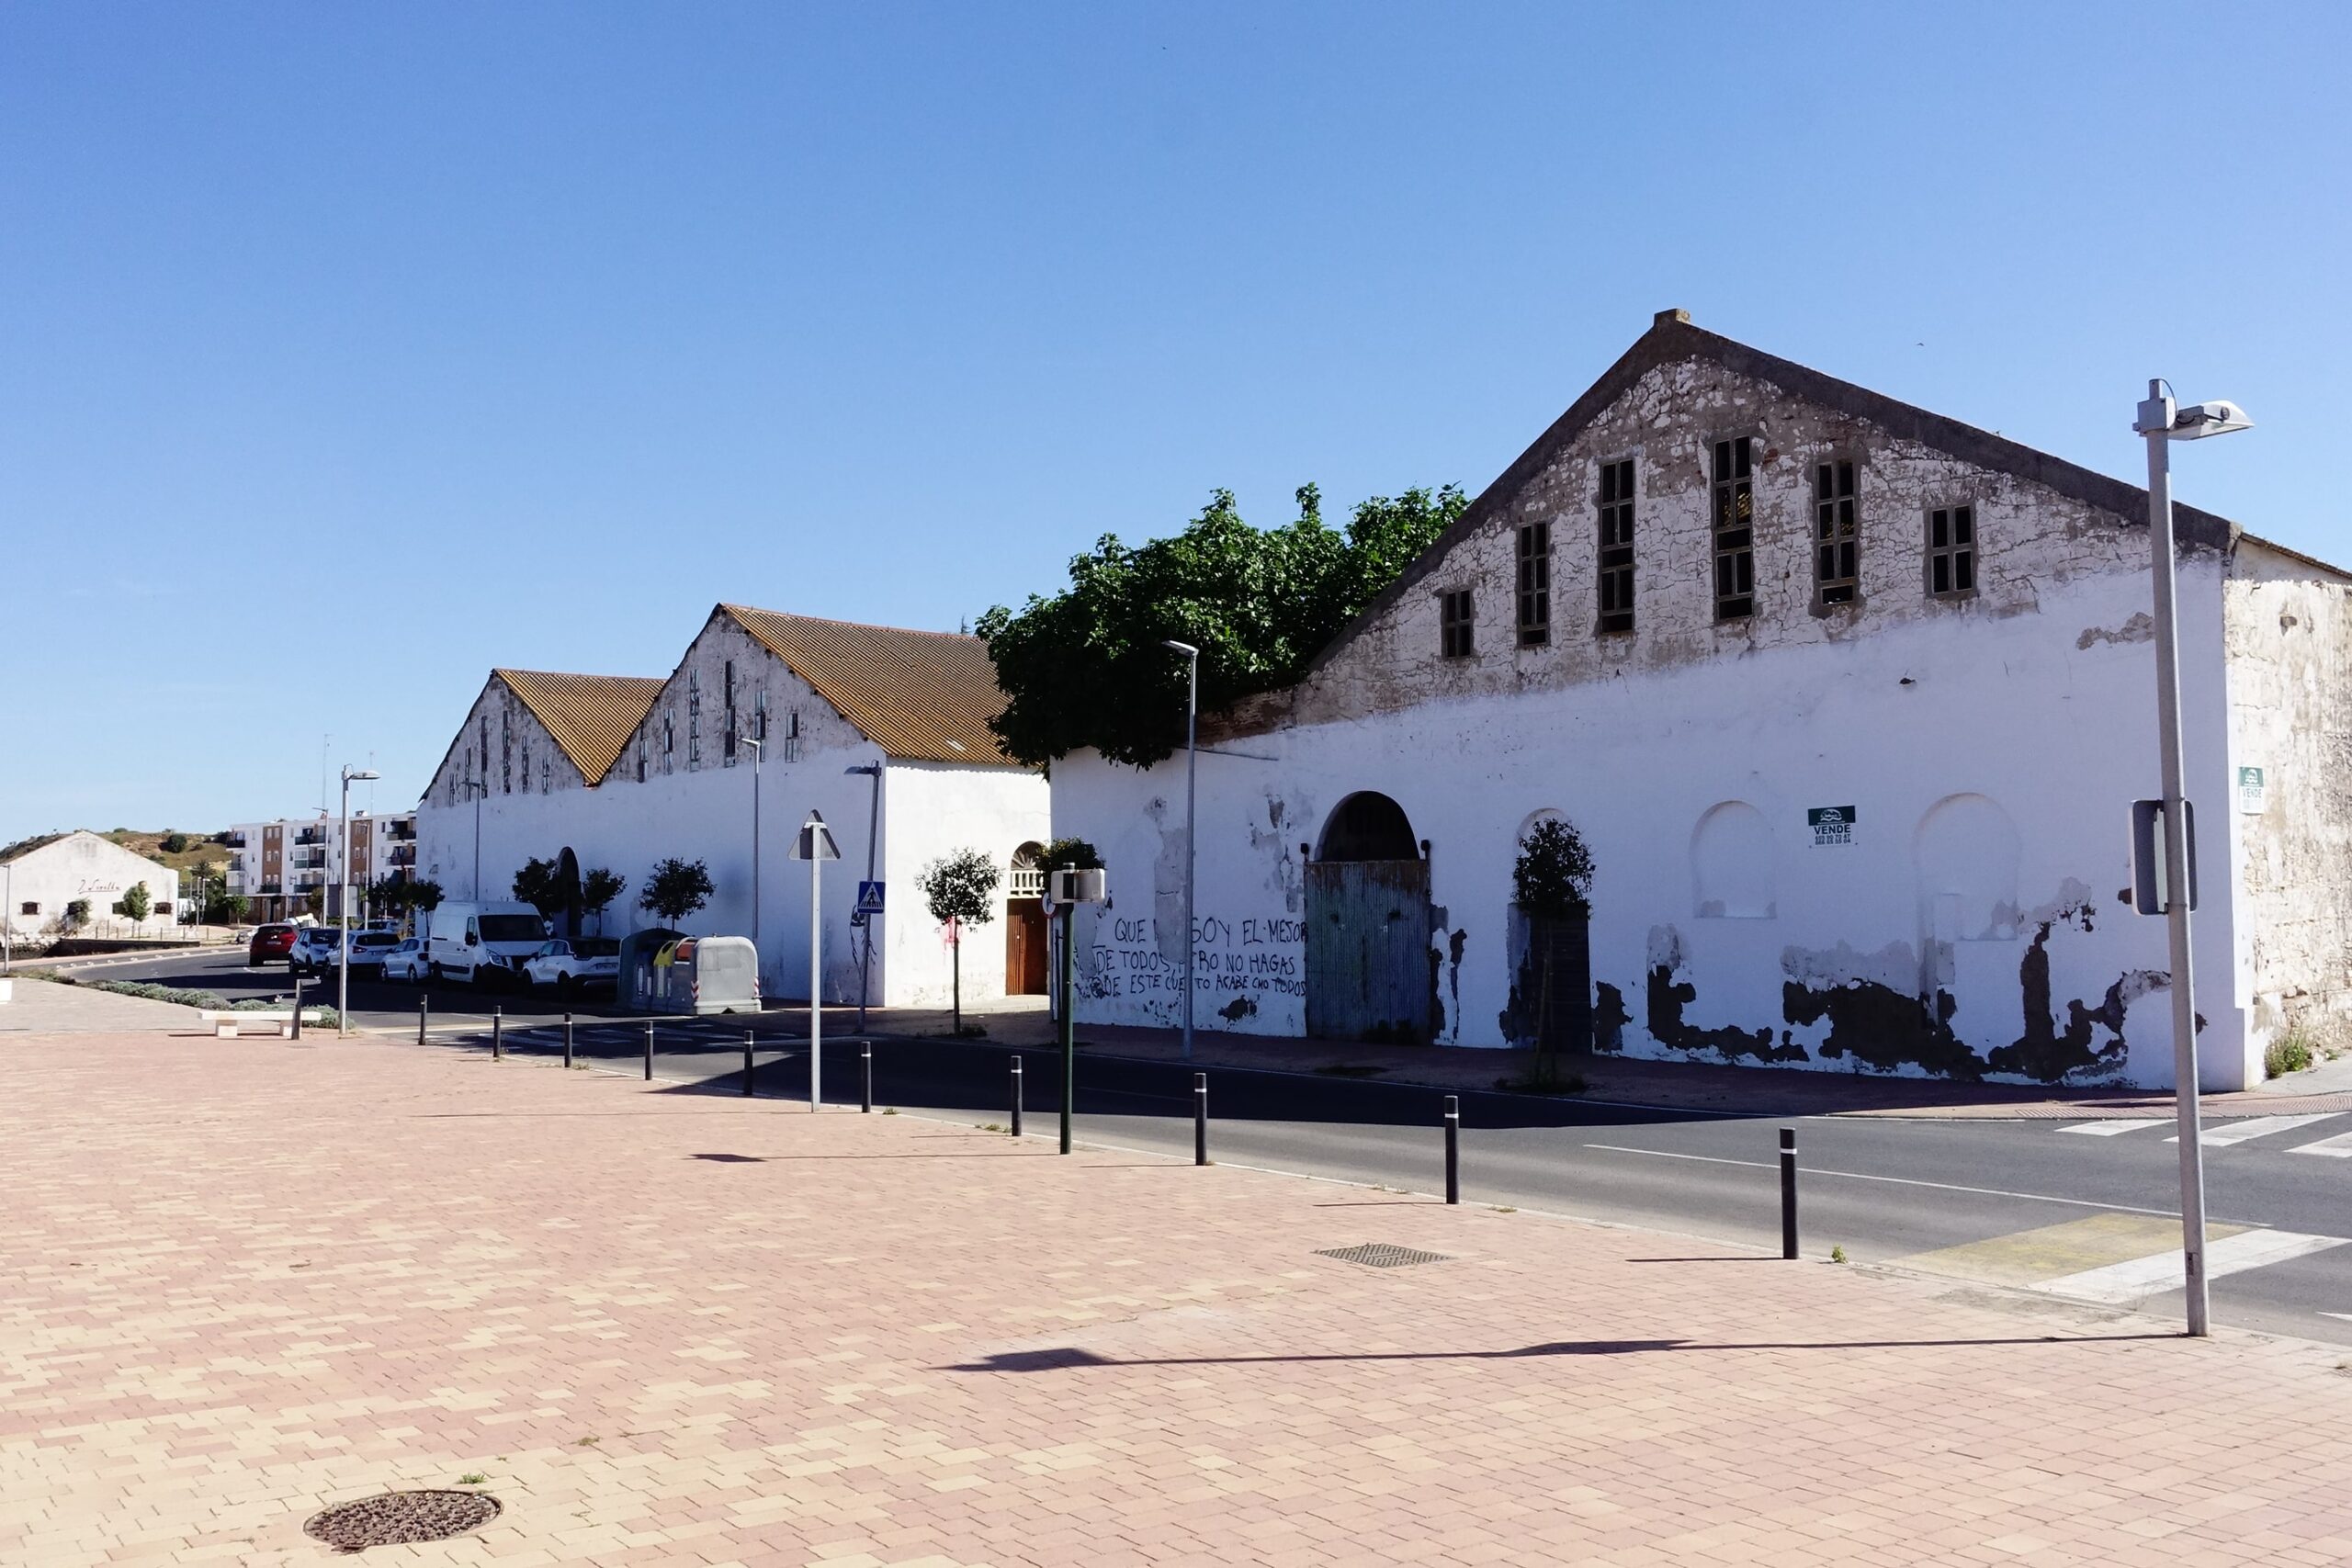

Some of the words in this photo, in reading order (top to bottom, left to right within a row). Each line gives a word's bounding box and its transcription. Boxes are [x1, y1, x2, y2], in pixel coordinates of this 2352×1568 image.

[1814, 824, 1851, 835] VENDE
[1114, 918, 1146, 943] QUE
[1096, 949, 1116, 976] DE
[1226, 953, 1244, 973] NO
[1250, 953, 1295, 975] HAGAS
[1130, 974, 1162, 994] ESTE
[1165, 976, 1211, 992] CUETO
[1216, 974, 1250, 992] ACABE
[1272, 976, 1306, 998] TODOS
